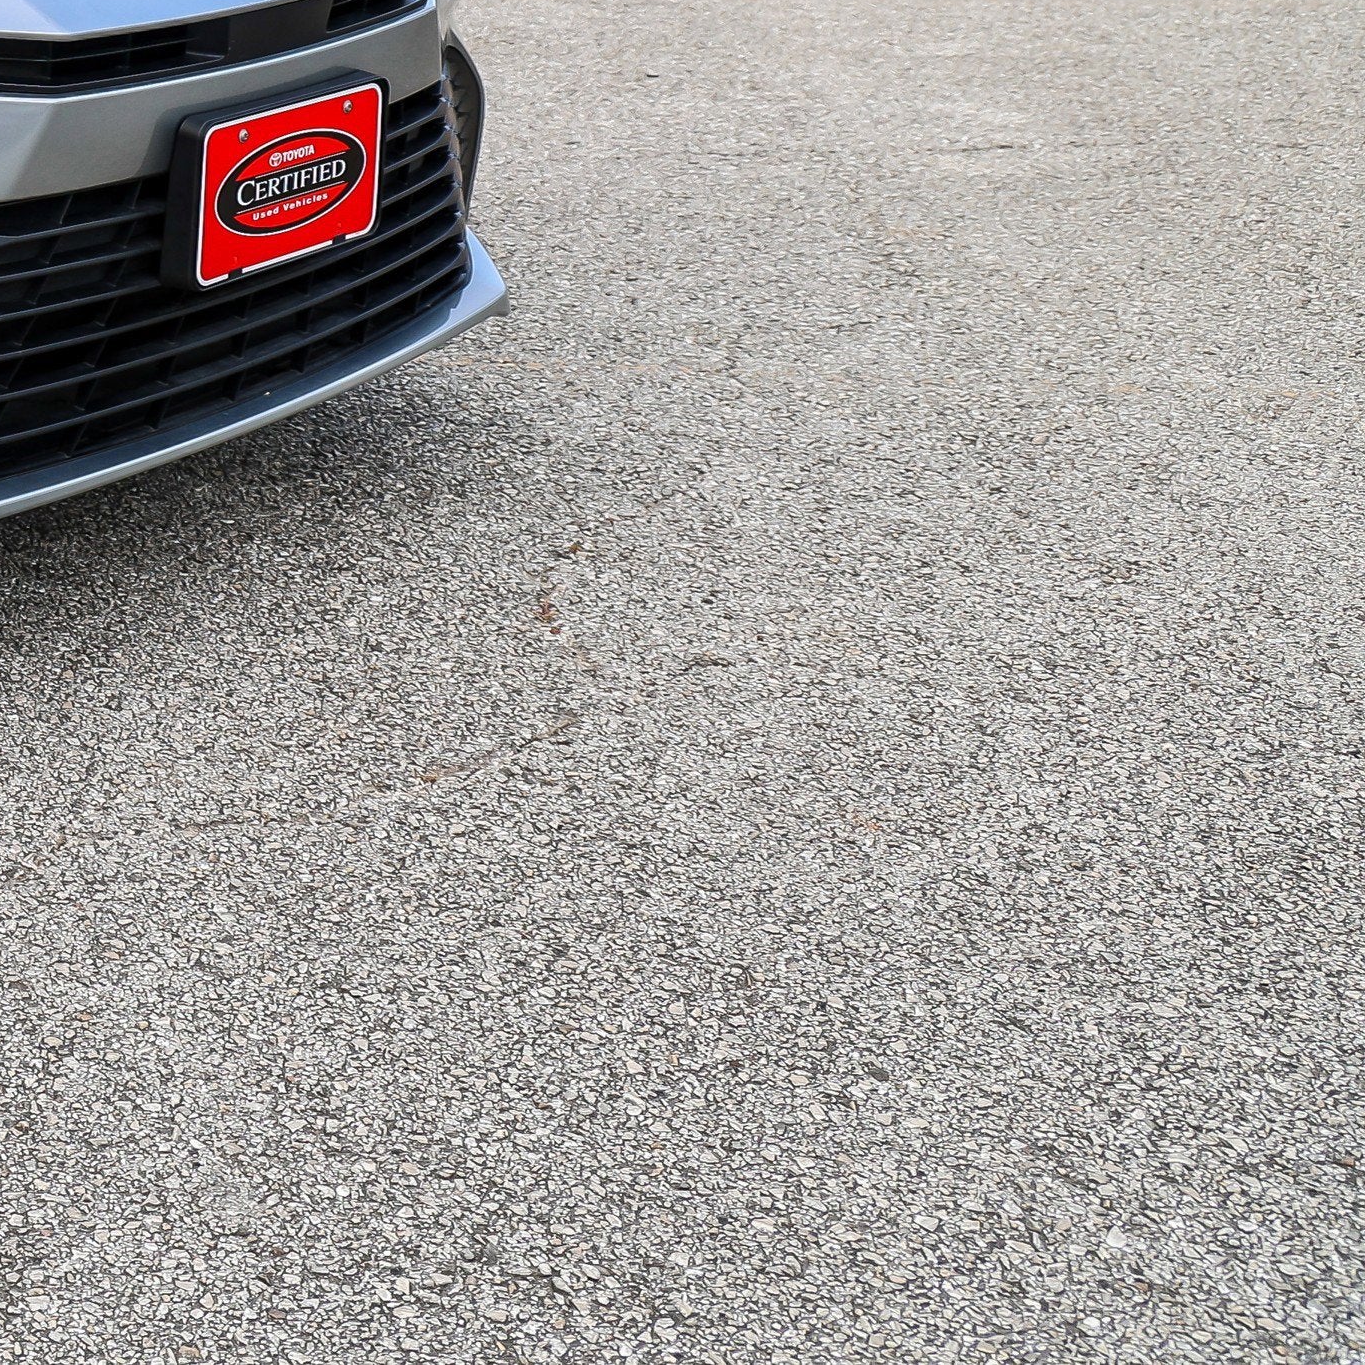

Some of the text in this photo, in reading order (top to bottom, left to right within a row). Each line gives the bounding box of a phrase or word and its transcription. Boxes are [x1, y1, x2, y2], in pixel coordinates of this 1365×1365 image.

[281, 144, 315, 162] TOYOTA
[236, 159, 347, 206] CERTIFIED
[253, 193, 328, 221] Used Vehicles
